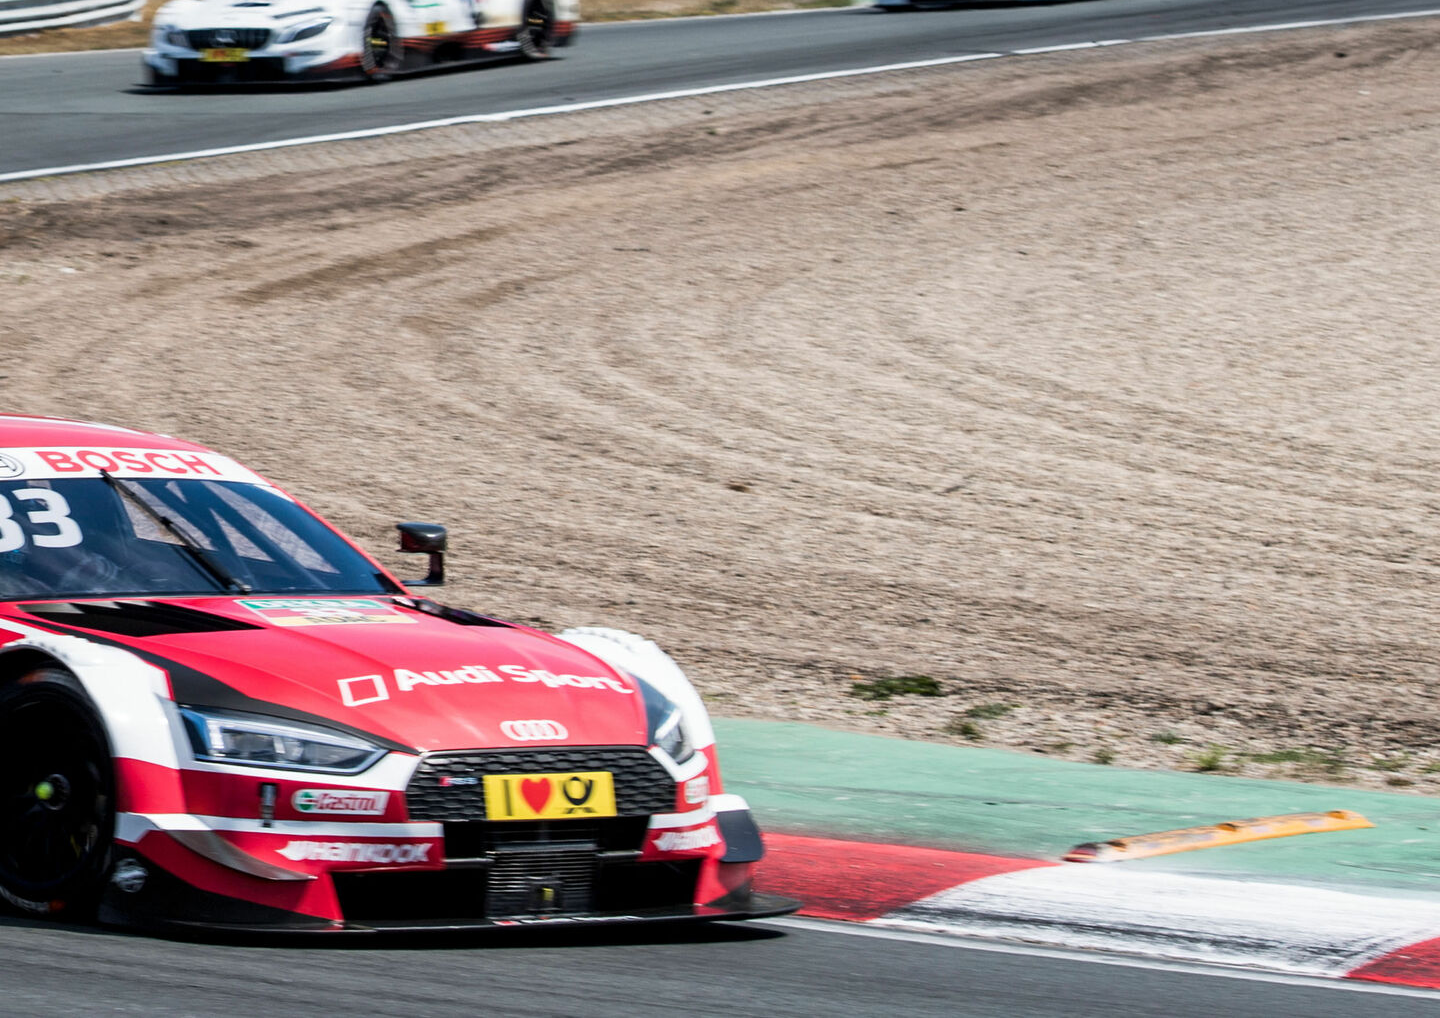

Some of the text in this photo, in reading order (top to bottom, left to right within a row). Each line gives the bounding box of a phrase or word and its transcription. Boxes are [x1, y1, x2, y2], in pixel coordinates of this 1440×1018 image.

[35, 450, 222, 476] BOSCH
[393, 664, 634, 694] Audi Sport
